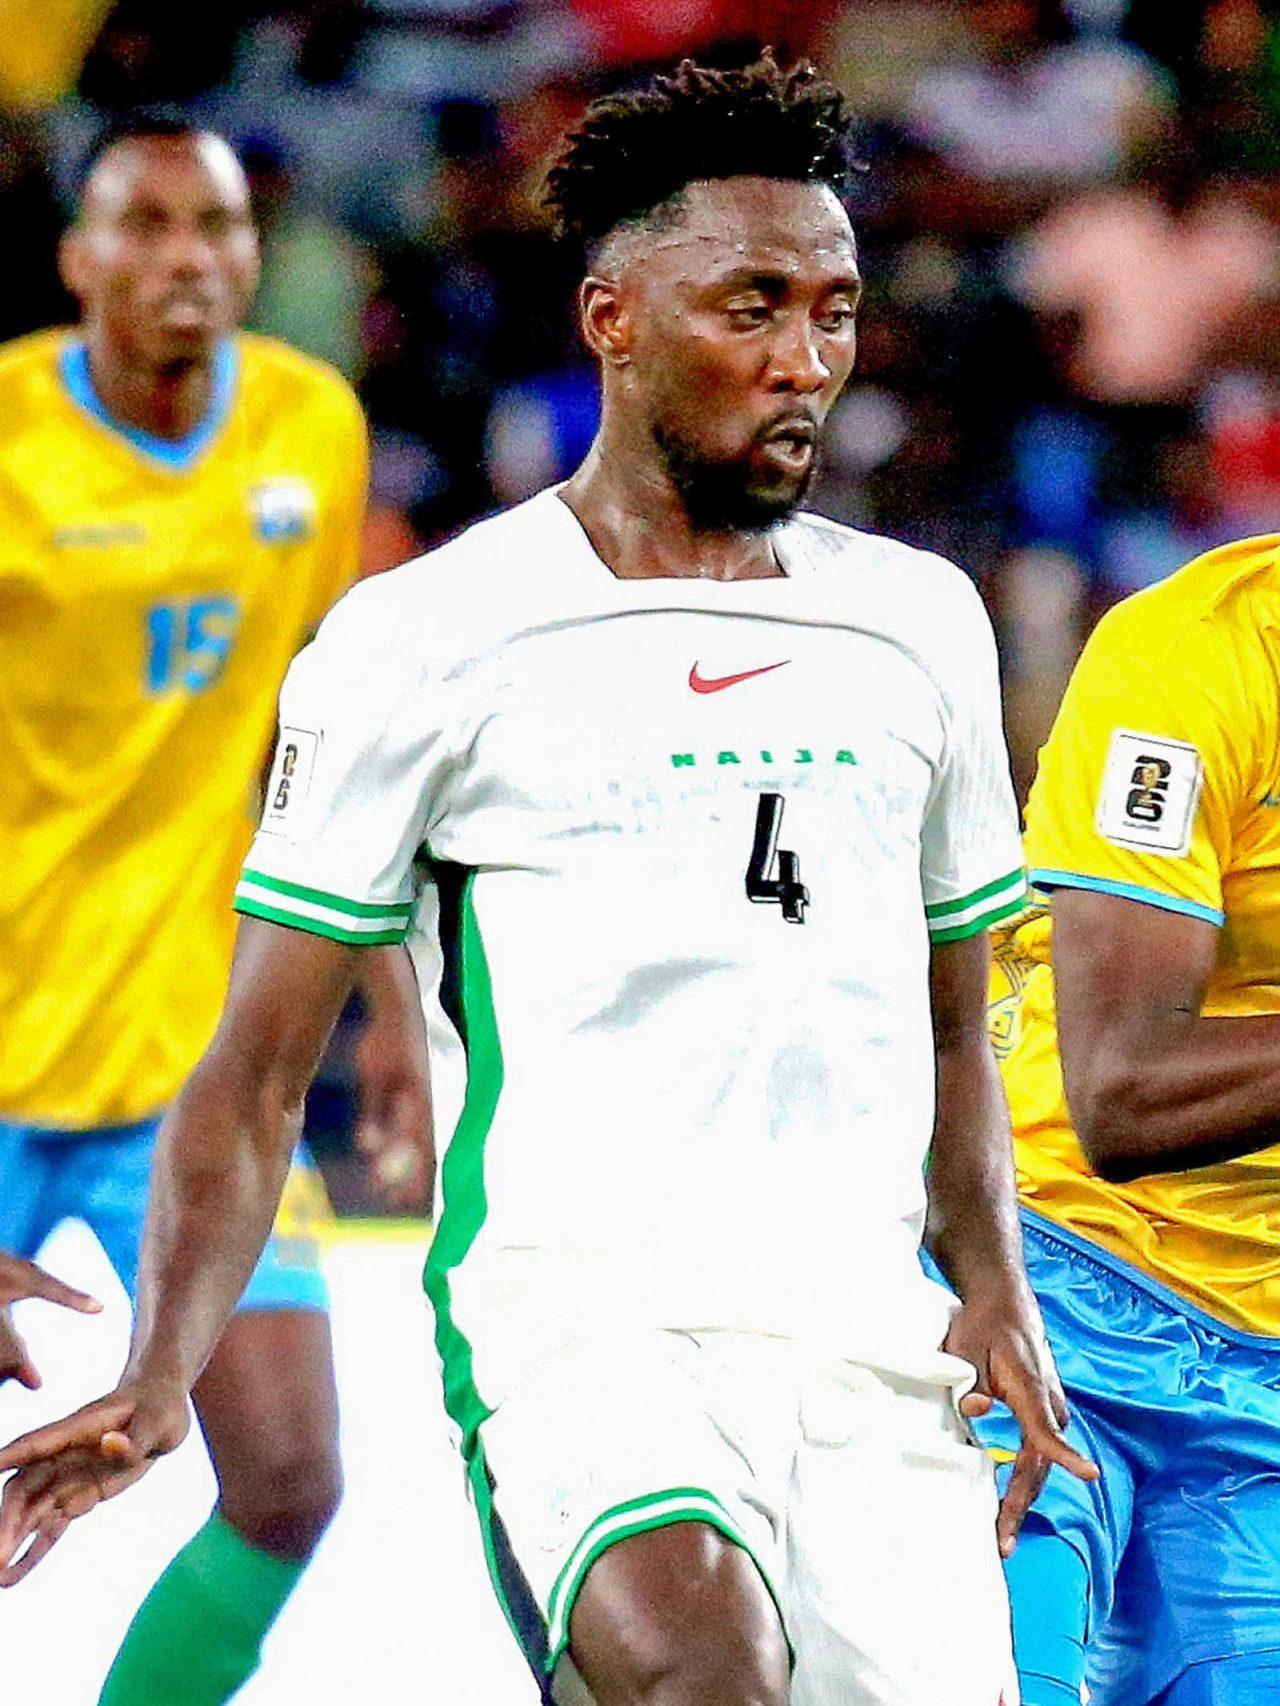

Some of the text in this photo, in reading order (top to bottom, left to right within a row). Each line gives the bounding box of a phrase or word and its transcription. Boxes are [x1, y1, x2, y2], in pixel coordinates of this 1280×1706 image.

[145, 595, 239, 695] 15
[670, 749, 858, 768] NAIJA
[745, 793, 810, 924] 4
